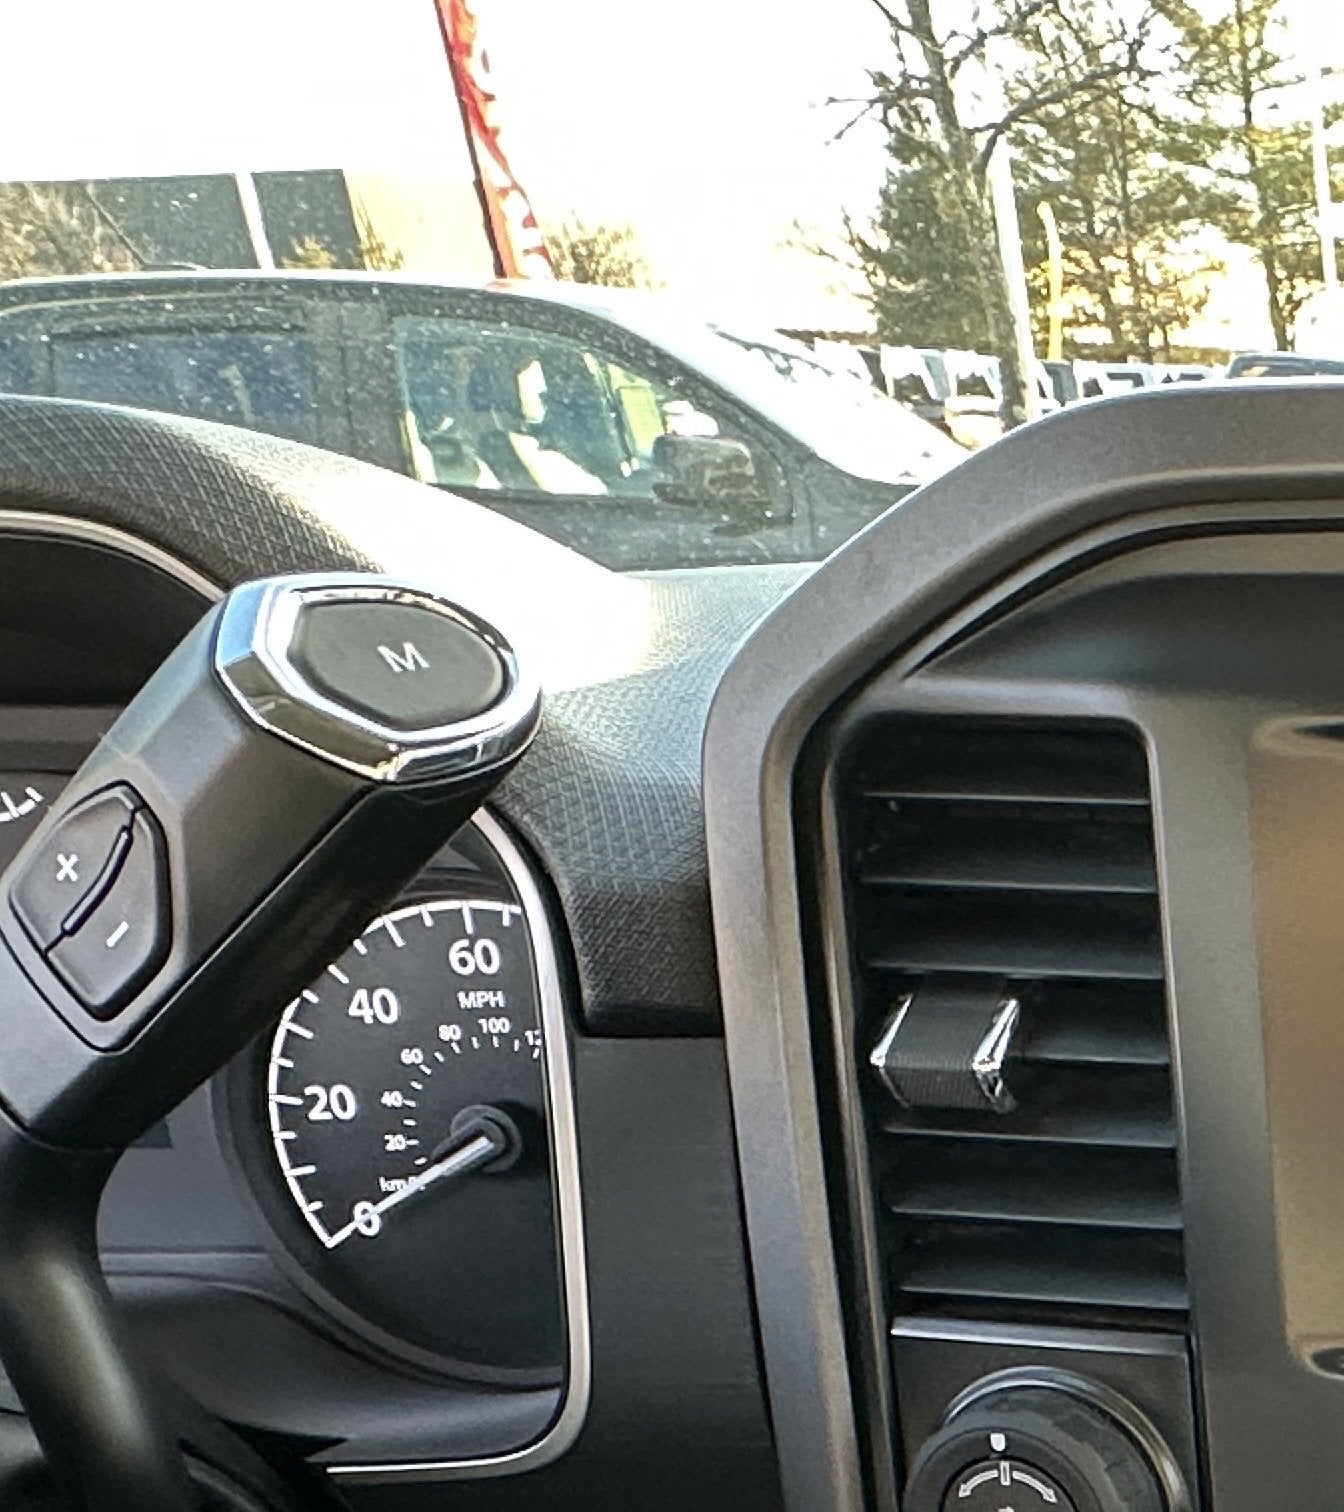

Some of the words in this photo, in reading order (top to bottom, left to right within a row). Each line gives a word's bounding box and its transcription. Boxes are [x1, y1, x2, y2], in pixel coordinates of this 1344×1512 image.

[378, 642, 431, 674] M
[448, 938, 501, 975] 60
[348, 987, 399, 1024] 40
[457, 991, 505, 1009] MPH
[438, 1024, 462, 1041] 80
[478, 1017, 511, 1034] 100
[400, 1048, 424, 1065] 60
[304, 1084, 356, 1120] 20
[380, 1090, 403, 1107] 40
